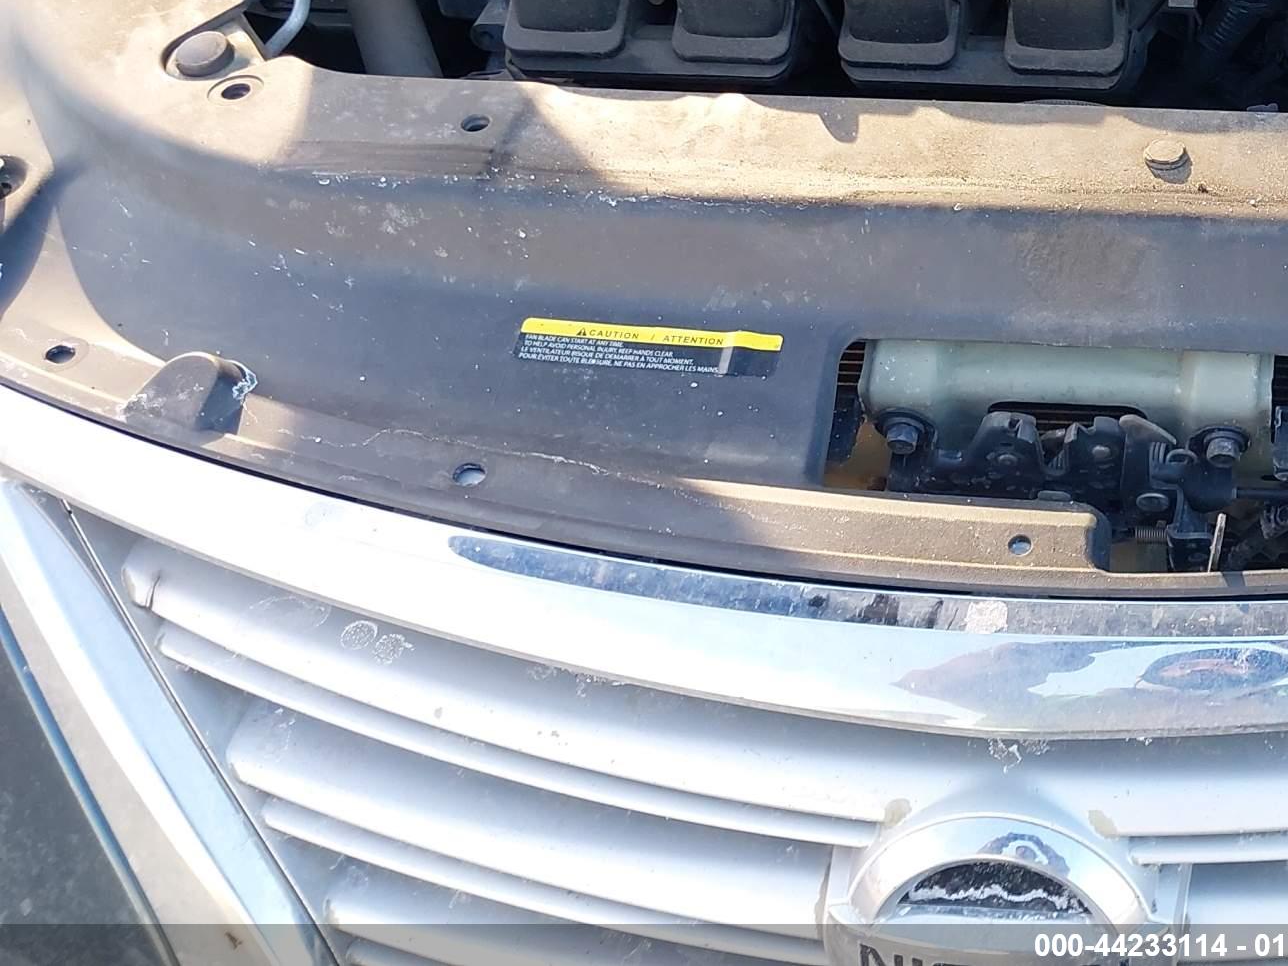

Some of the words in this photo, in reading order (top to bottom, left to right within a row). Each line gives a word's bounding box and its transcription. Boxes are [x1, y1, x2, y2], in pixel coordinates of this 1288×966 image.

[589, 329, 639, 339] CAUTION
[663, 335, 724, 346] ATTENTION
[529, 347, 571, 356] VENTILATEUR
[560, 355, 580, 364] TOUTE
[646, 363, 685, 371] APPROCHER
